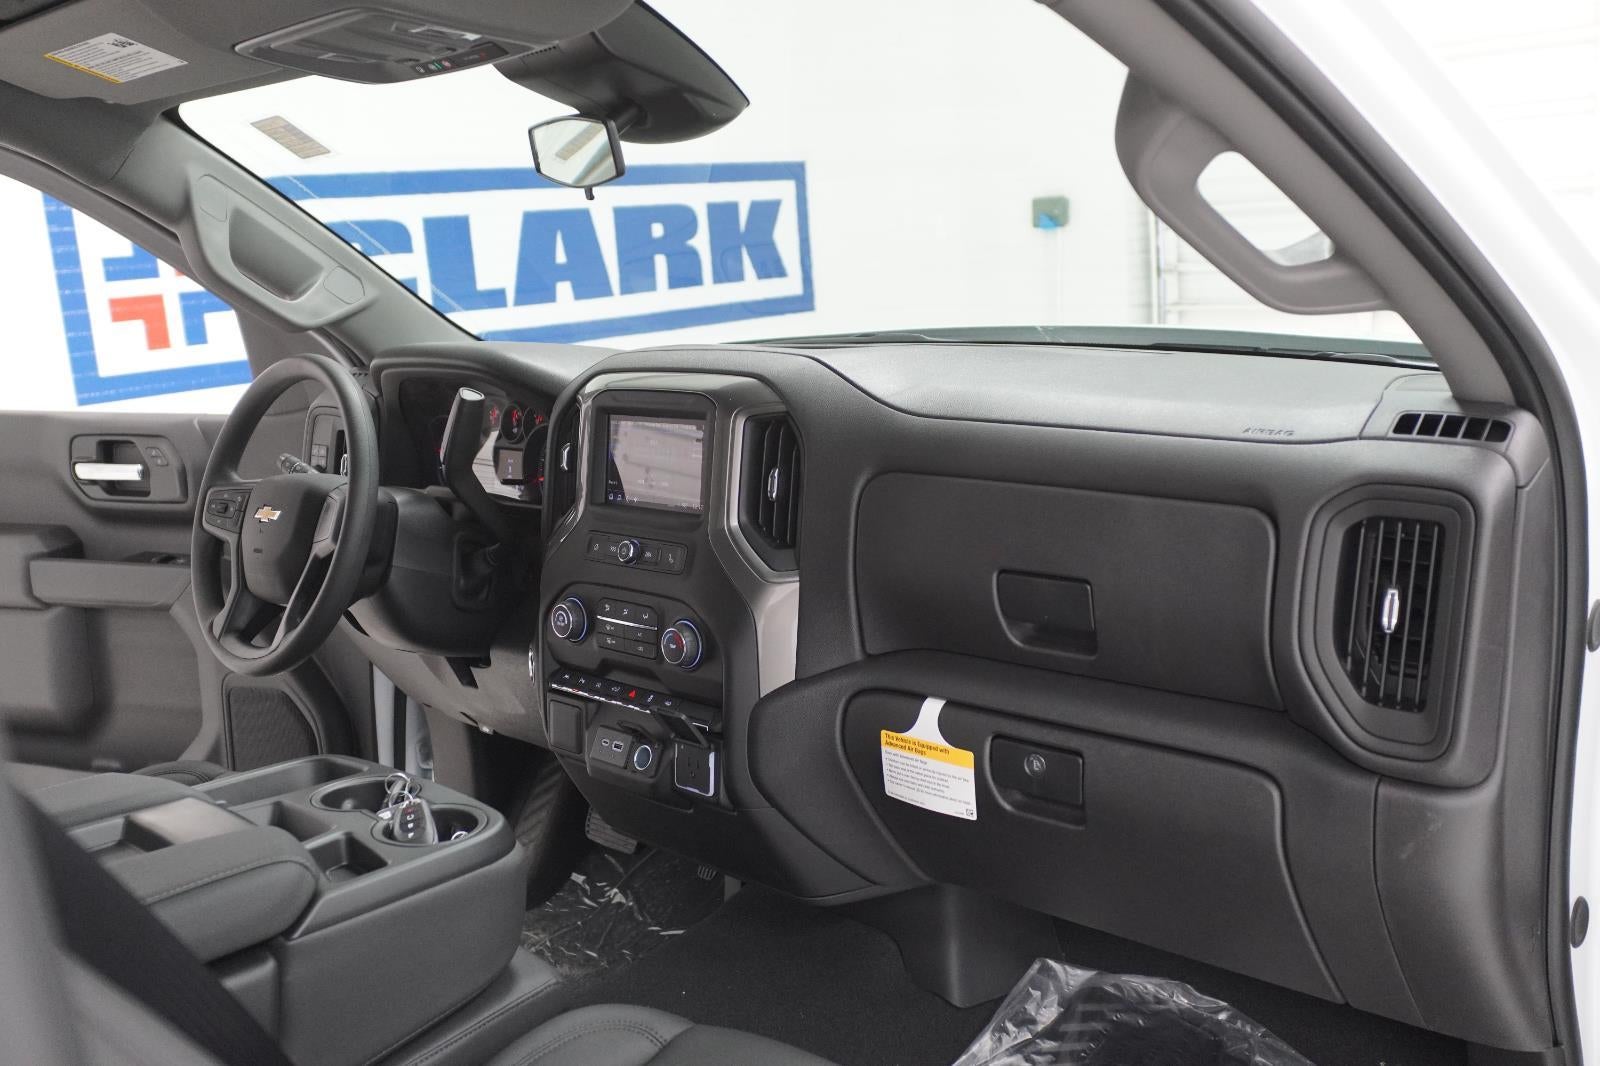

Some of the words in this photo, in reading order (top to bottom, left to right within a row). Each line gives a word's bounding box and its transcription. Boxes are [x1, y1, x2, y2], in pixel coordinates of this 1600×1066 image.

[1242, 427, 1295, 436] AIRBAG
[885, 733, 894, 741] This
[895, 736, 911, 744] Vehicle
[917, 741, 938, 752] Equipped
[939, 747, 950, 755] with
[885, 740, 906, 750] Advanced
[914, 747, 927, 756] Bags
